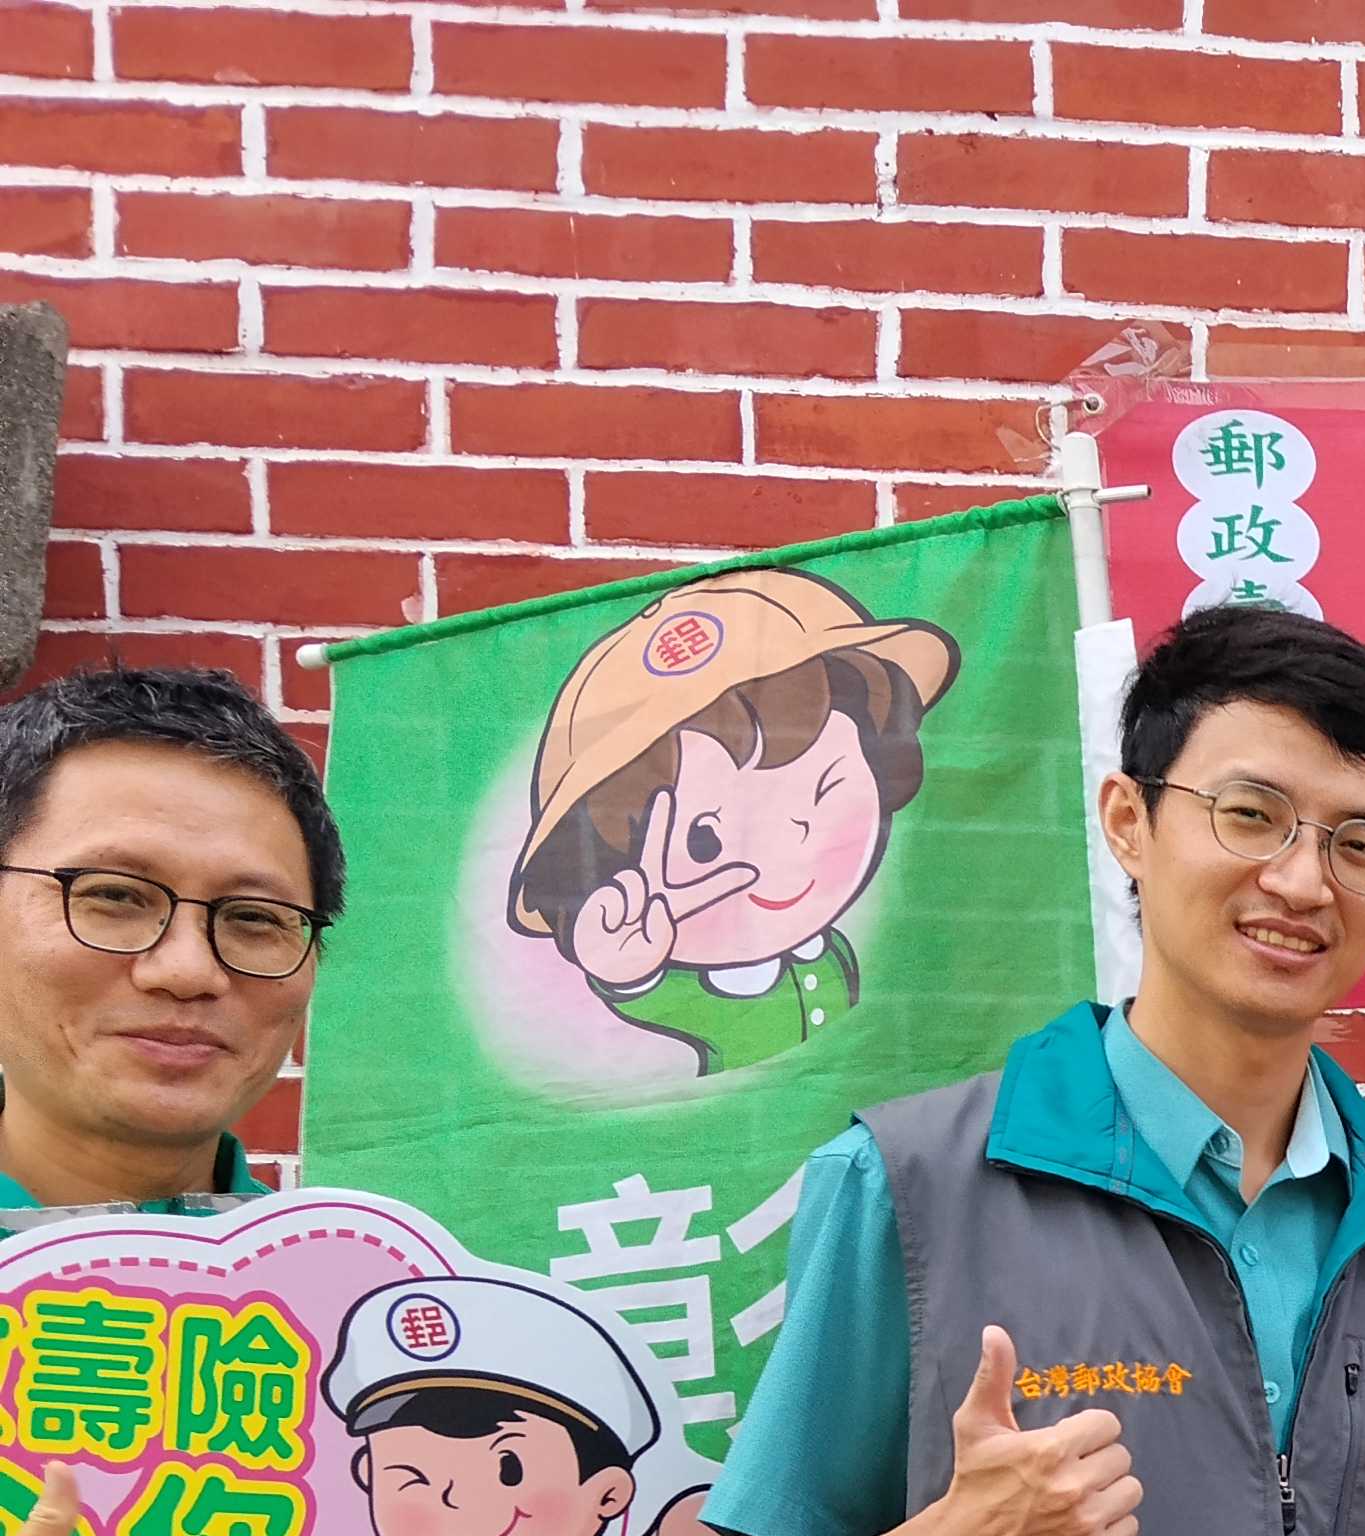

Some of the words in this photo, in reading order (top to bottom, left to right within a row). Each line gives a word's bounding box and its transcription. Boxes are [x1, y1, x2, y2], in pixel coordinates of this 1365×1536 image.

[0, 1300, 299, 1460] 壽險
[1014, 1361, 1193, 1399] 台灣郵政協會
